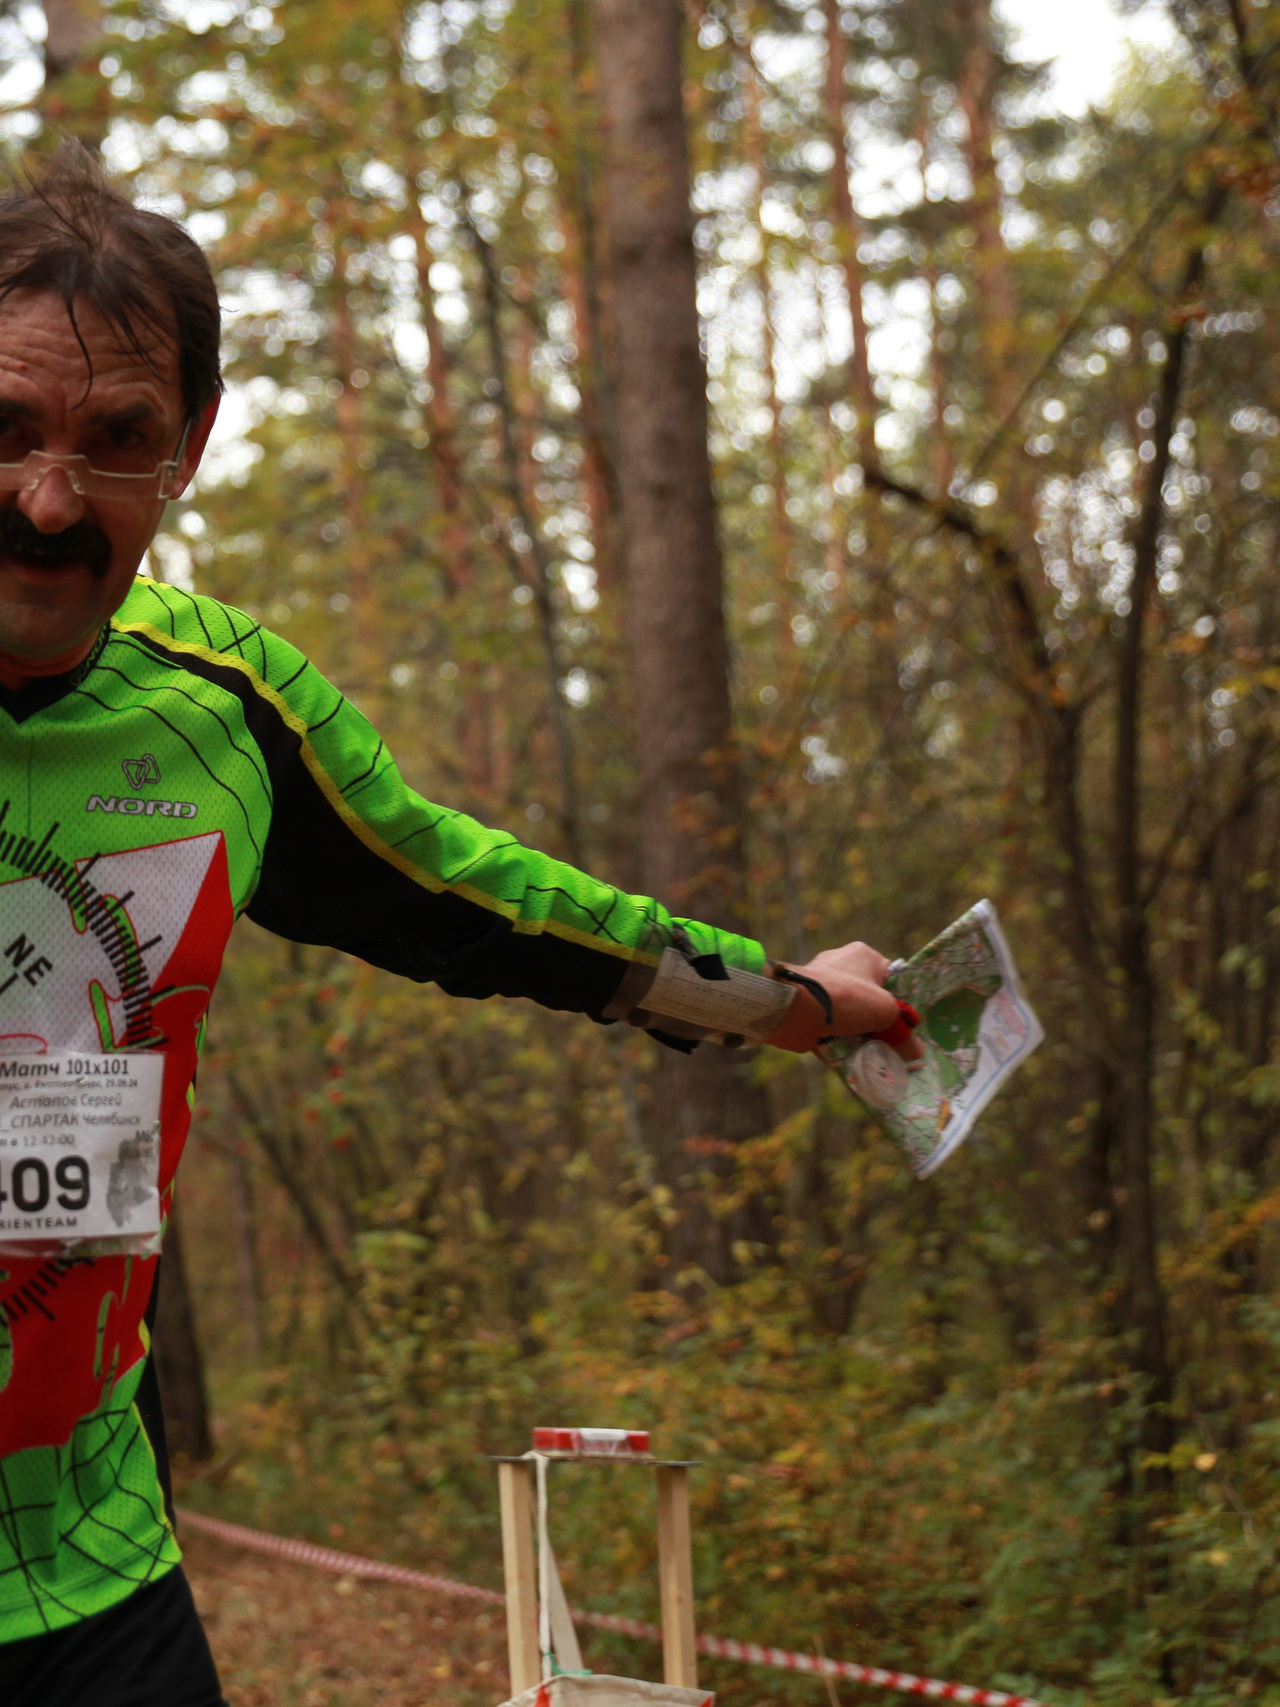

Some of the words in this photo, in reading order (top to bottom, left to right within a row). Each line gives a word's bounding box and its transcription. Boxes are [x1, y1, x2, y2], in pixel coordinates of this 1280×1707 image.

[86, 794, 198, 819] NORD
[4, 932, 54, 987] NE
[81, 1093, 122, 1107] Сергей
[83, 1112, 141, 1126] Челябинск
[11, 1139, 18, 1147] в
[23, 1134, 75, 1147] 12:42:00
